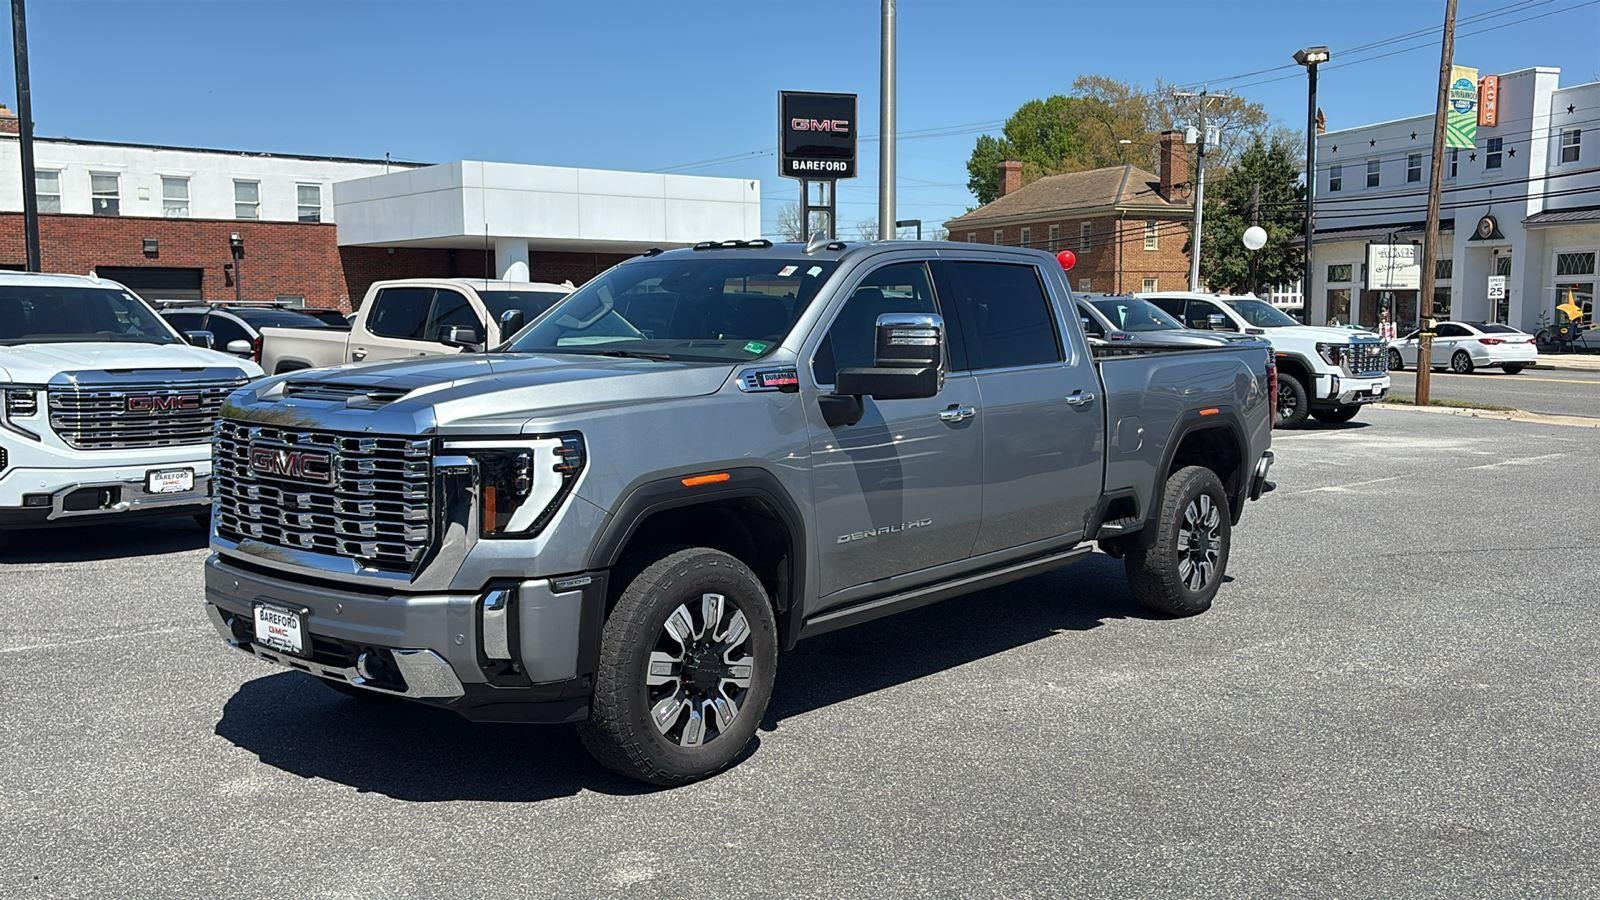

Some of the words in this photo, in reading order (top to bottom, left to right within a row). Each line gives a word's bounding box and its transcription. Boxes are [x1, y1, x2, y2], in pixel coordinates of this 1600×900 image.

[1486, 79, 1495, 122] ACME
[791, 118, 849, 132] GMC
[792, 160, 847, 171] BAREFORD
[1490, 287, 1503, 296] 25
[764, 373, 797, 381] DURAMAX
[129, 395, 199, 411] GMC
[251, 447, 329, 480] GMC
[154, 472, 189, 480] BAREFORD
[837, 524, 905, 544] DENALI
[908, 518, 932, 529] HD
[260, 610, 297, 629] BAREFORD
[268, 625, 289, 637] GMC
